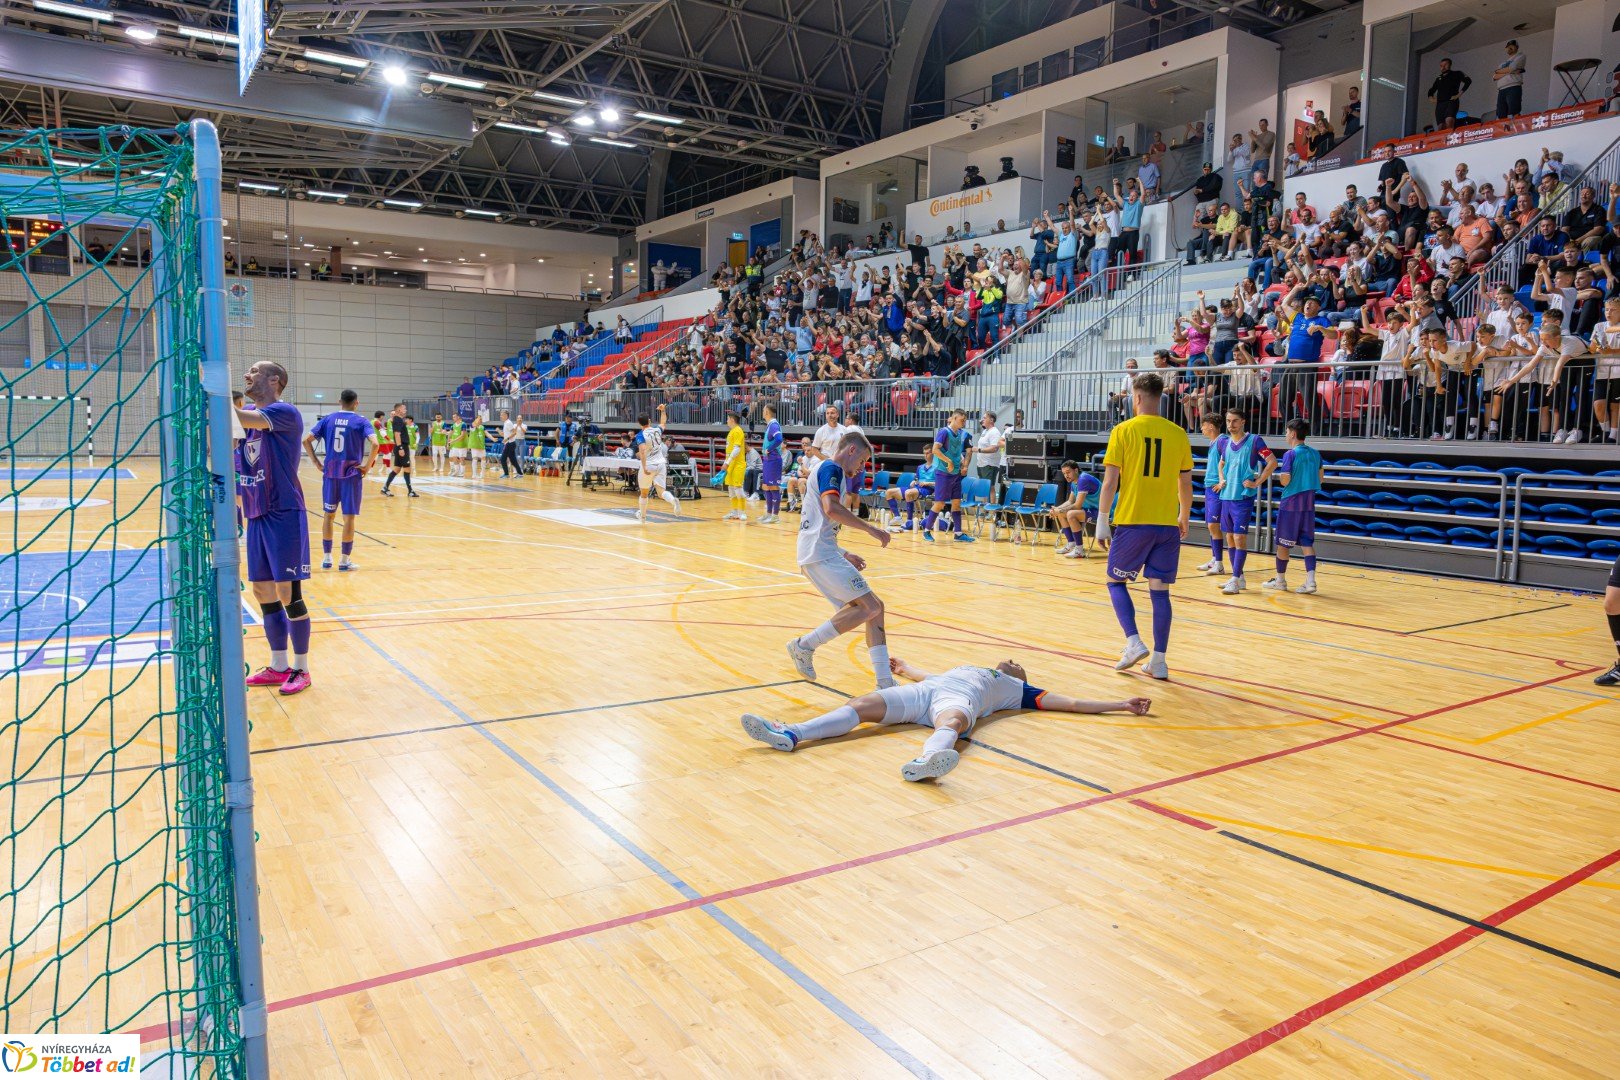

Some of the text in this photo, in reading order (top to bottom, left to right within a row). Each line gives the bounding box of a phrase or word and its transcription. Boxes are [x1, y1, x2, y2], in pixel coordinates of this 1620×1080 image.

[1551, 109, 1584, 121] Eissmann
[1463, 127, 1493, 138] Eissmann
[930, 190, 983, 216] Continental
[334, 427, 346, 453] 5
[1143, 437, 1162, 477] 11
